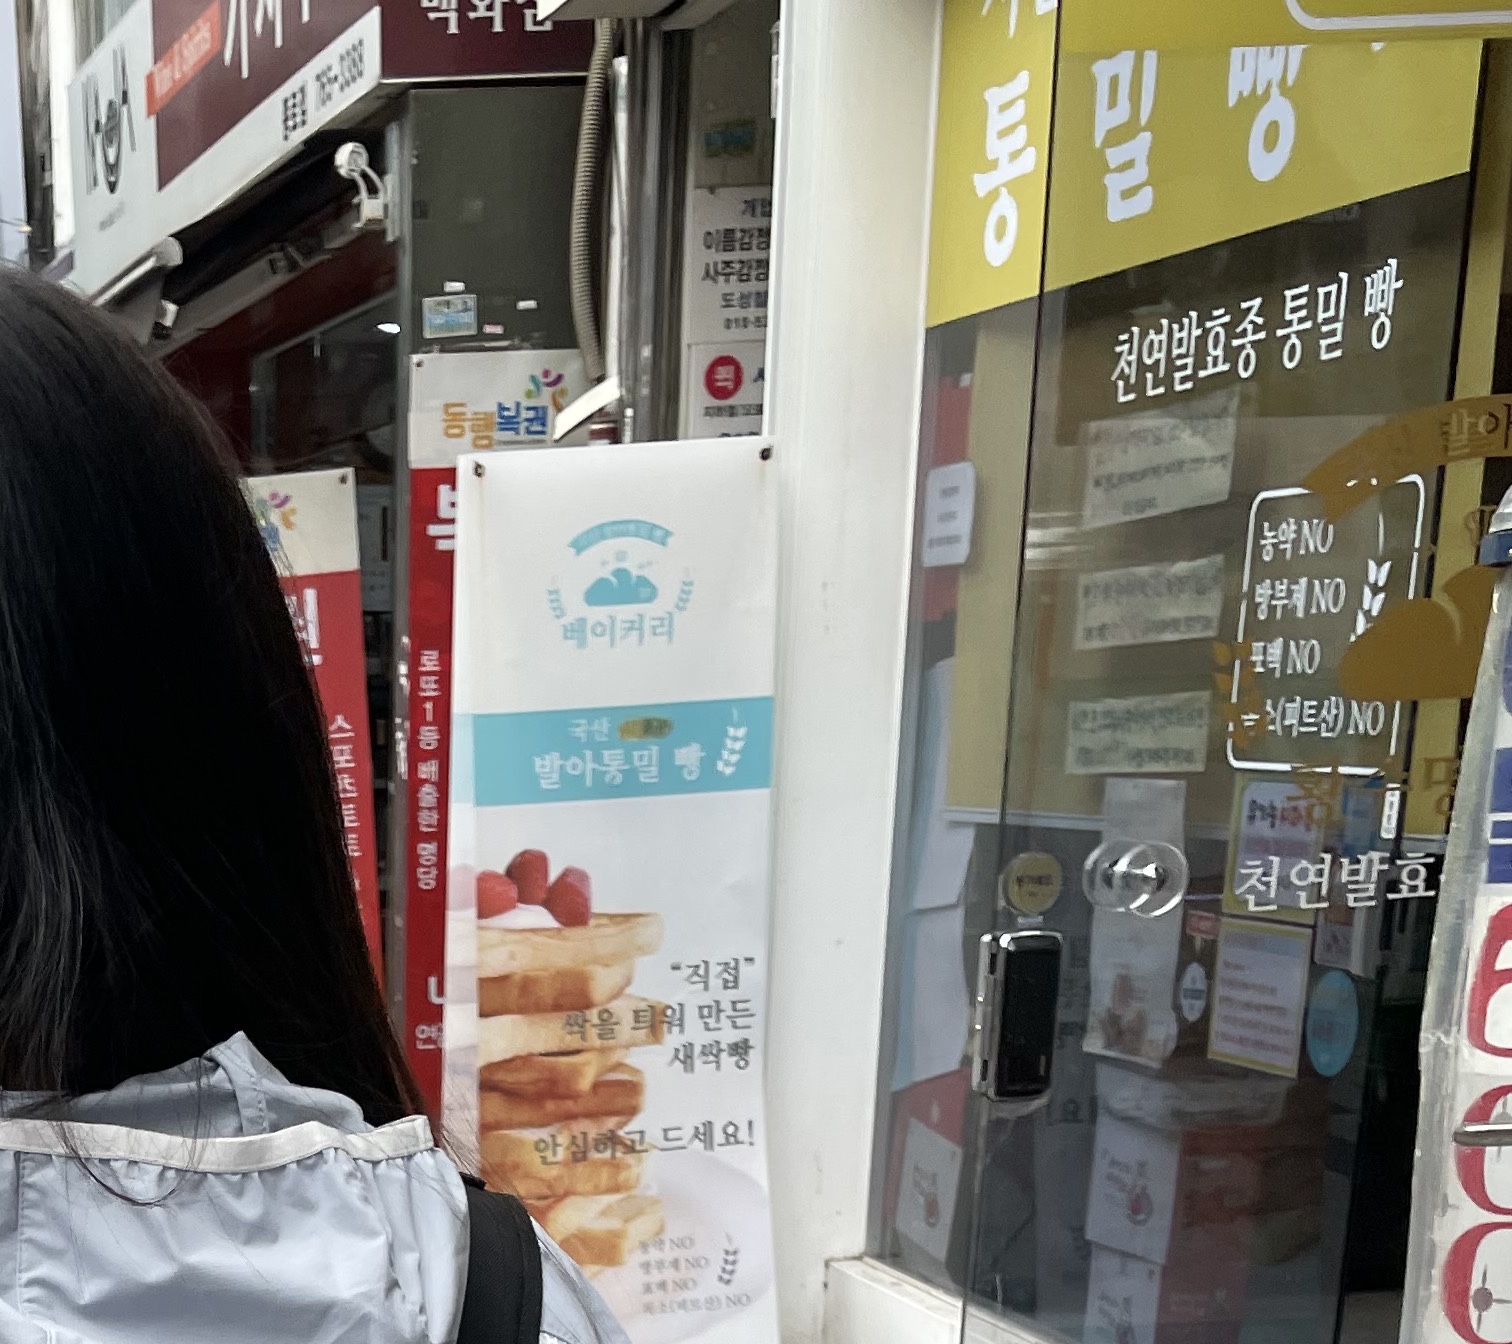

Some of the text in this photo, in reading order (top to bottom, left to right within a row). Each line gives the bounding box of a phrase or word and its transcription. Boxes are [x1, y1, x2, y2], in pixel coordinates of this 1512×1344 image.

[1110, 257, 1404, 404] 천연발효종 통밀 빵
[441, 400, 549, 450] 동행복권
[1259, 517, 1298, 562] 농약
[1253, 576, 1308, 620] 방부제
[1309, 577, 1346, 614] NO
[562, 612, 675, 649] 베이커리
[1285, 638, 1322, 675] NO
[568, 716, 612, 742] 국산
[1346, 699, 1386, 737] NO
[532, 741, 707, 790] 발아통밀 빵
[1234, 850, 1438, 912] 천연발효
[562, 1007, 620, 1042] 싹을
[696, 1000, 757, 1032] 만든
[667, 1037, 756, 1074] 새싹빵
[533, 1119, 756, 1166] 안심하고 드세요!
[669, 1236, 696, 1251] NO
[684, 1255, 710, 1271] NO
[671, 1276, 699, 1292] NO
[725, 1292, 751, 1308] NO
